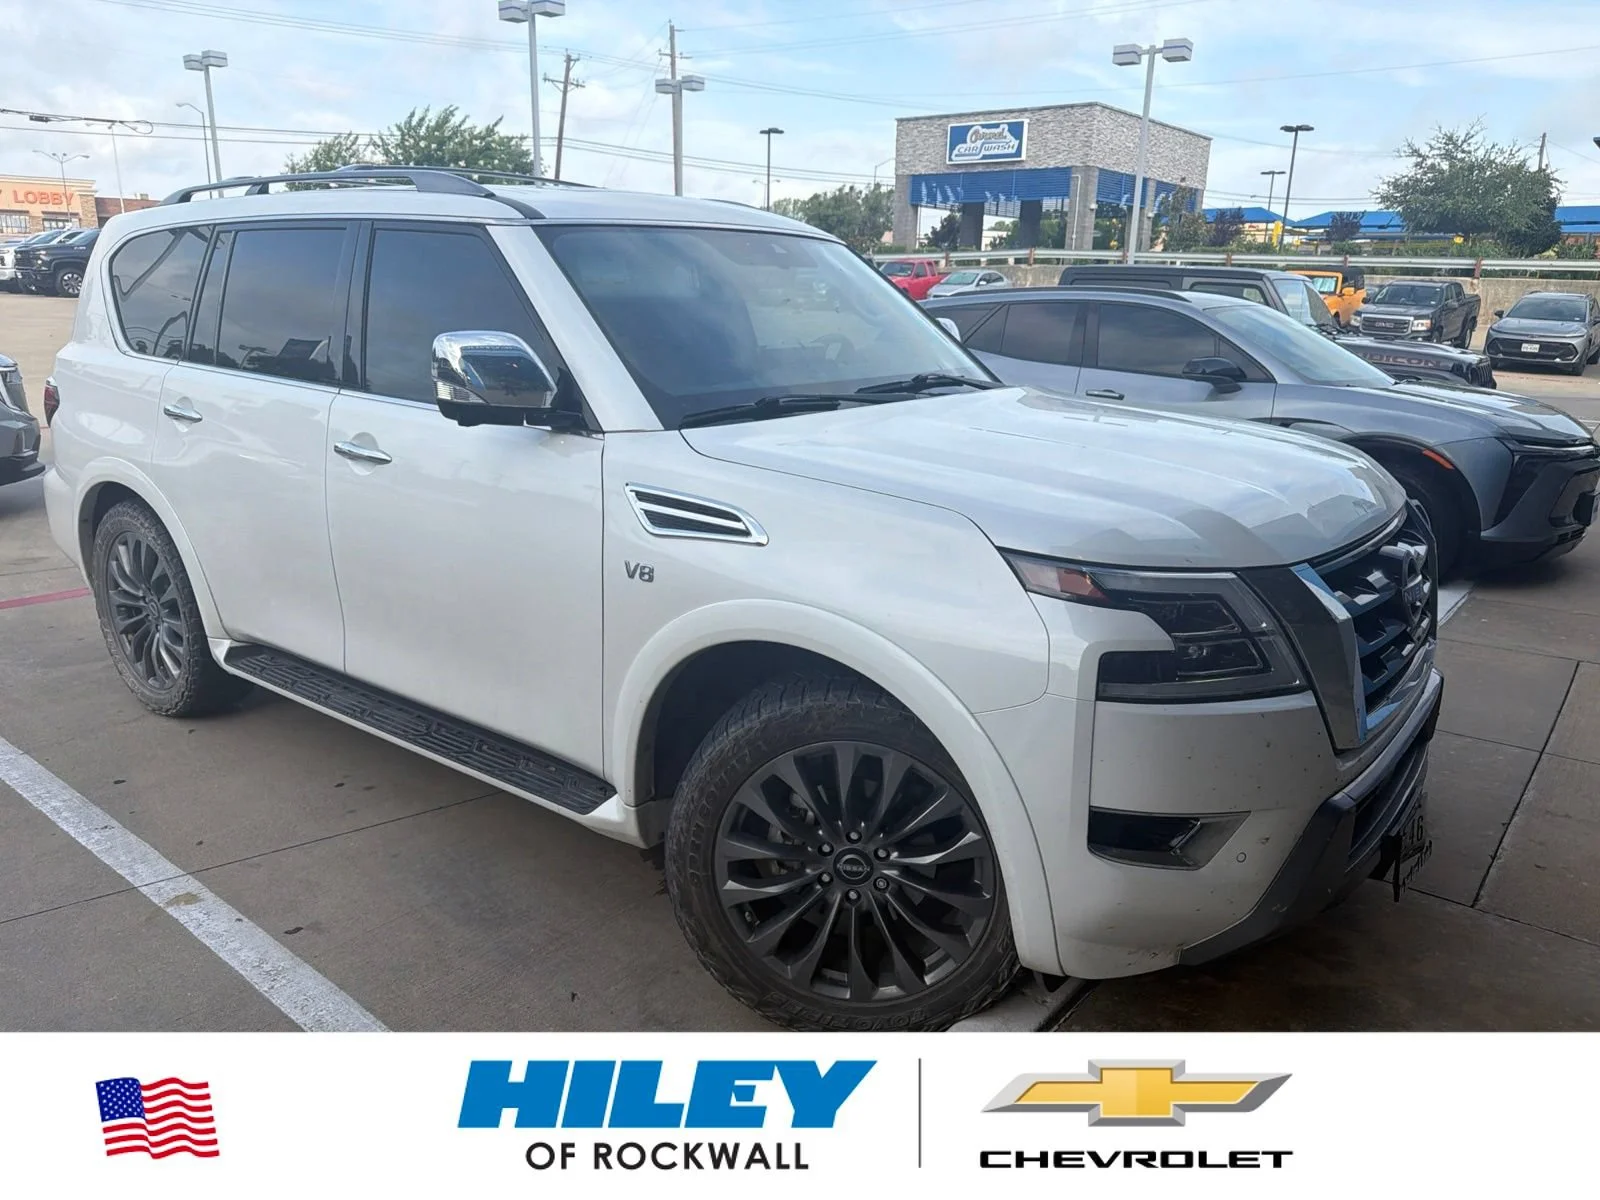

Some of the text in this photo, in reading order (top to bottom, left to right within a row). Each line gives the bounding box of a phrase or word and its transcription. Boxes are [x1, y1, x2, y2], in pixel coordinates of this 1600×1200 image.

[957, 143, 1015, 153] CAR WASH
[12, 190, 74, 206] LOBBY
[624, 560, 655, 583] V8
